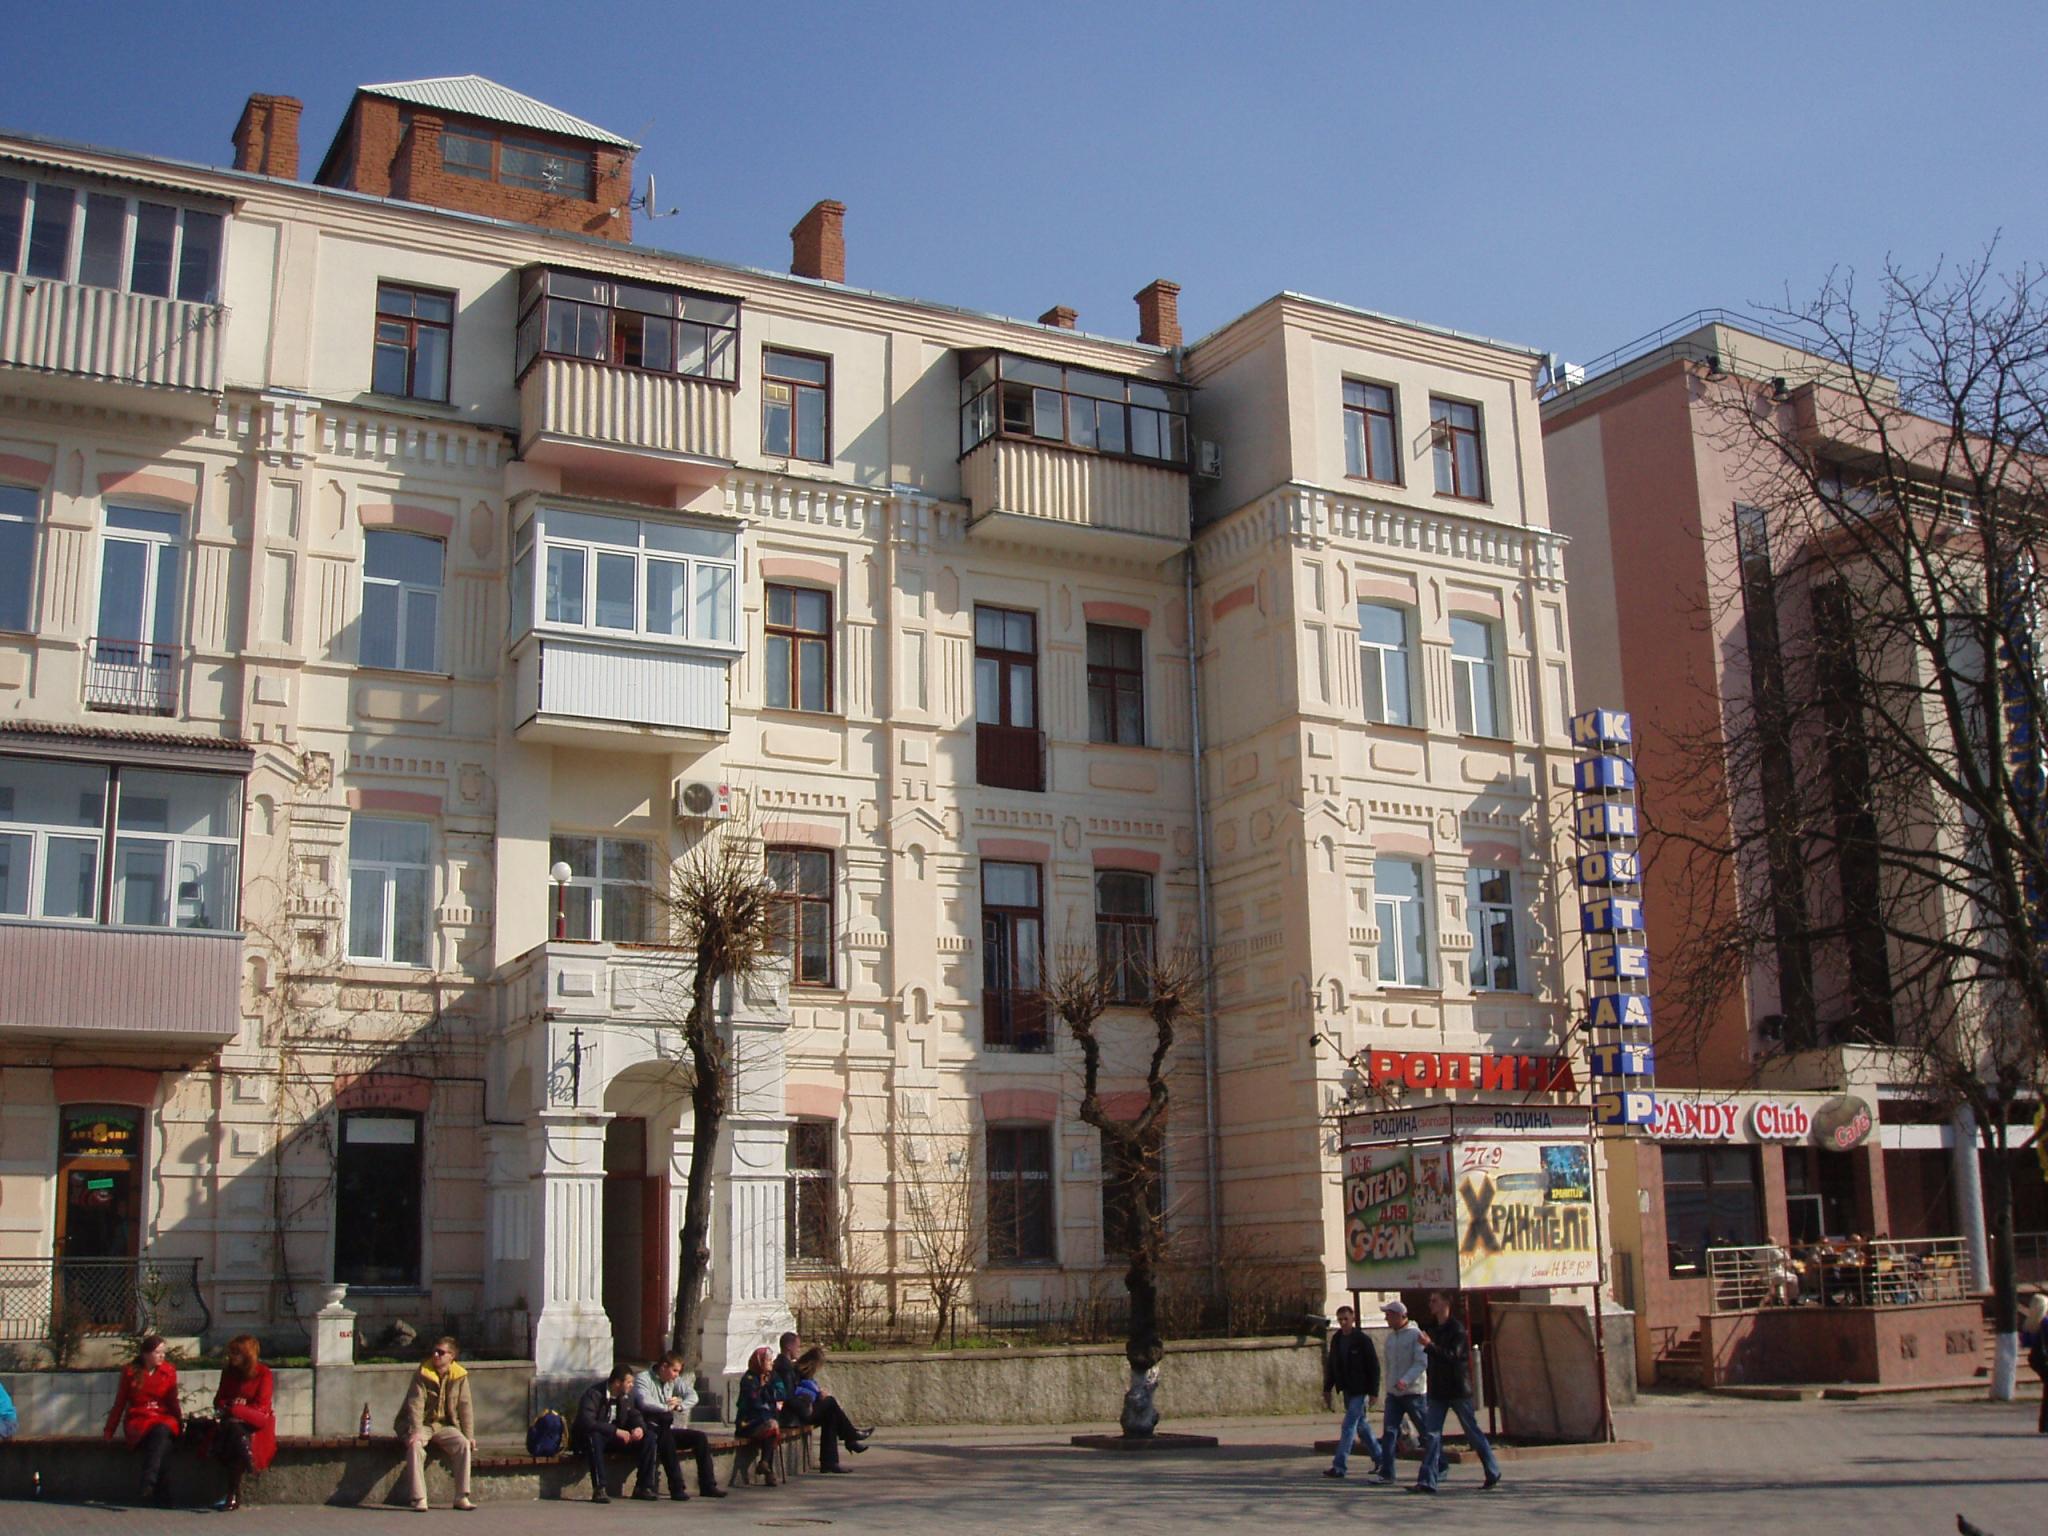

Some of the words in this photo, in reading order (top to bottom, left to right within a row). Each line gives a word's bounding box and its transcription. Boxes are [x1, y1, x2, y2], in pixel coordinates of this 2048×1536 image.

[1369, 1050, 1578, 1092] РОДИНА
[1373, 1115, 1418, 1137] РОДИНА
[1494, 1112, 1551, 1132] РОДИНА
[1647, 1102, 1739, 1136] CANDY
[1755, 1102, 1809, 1136] Club
